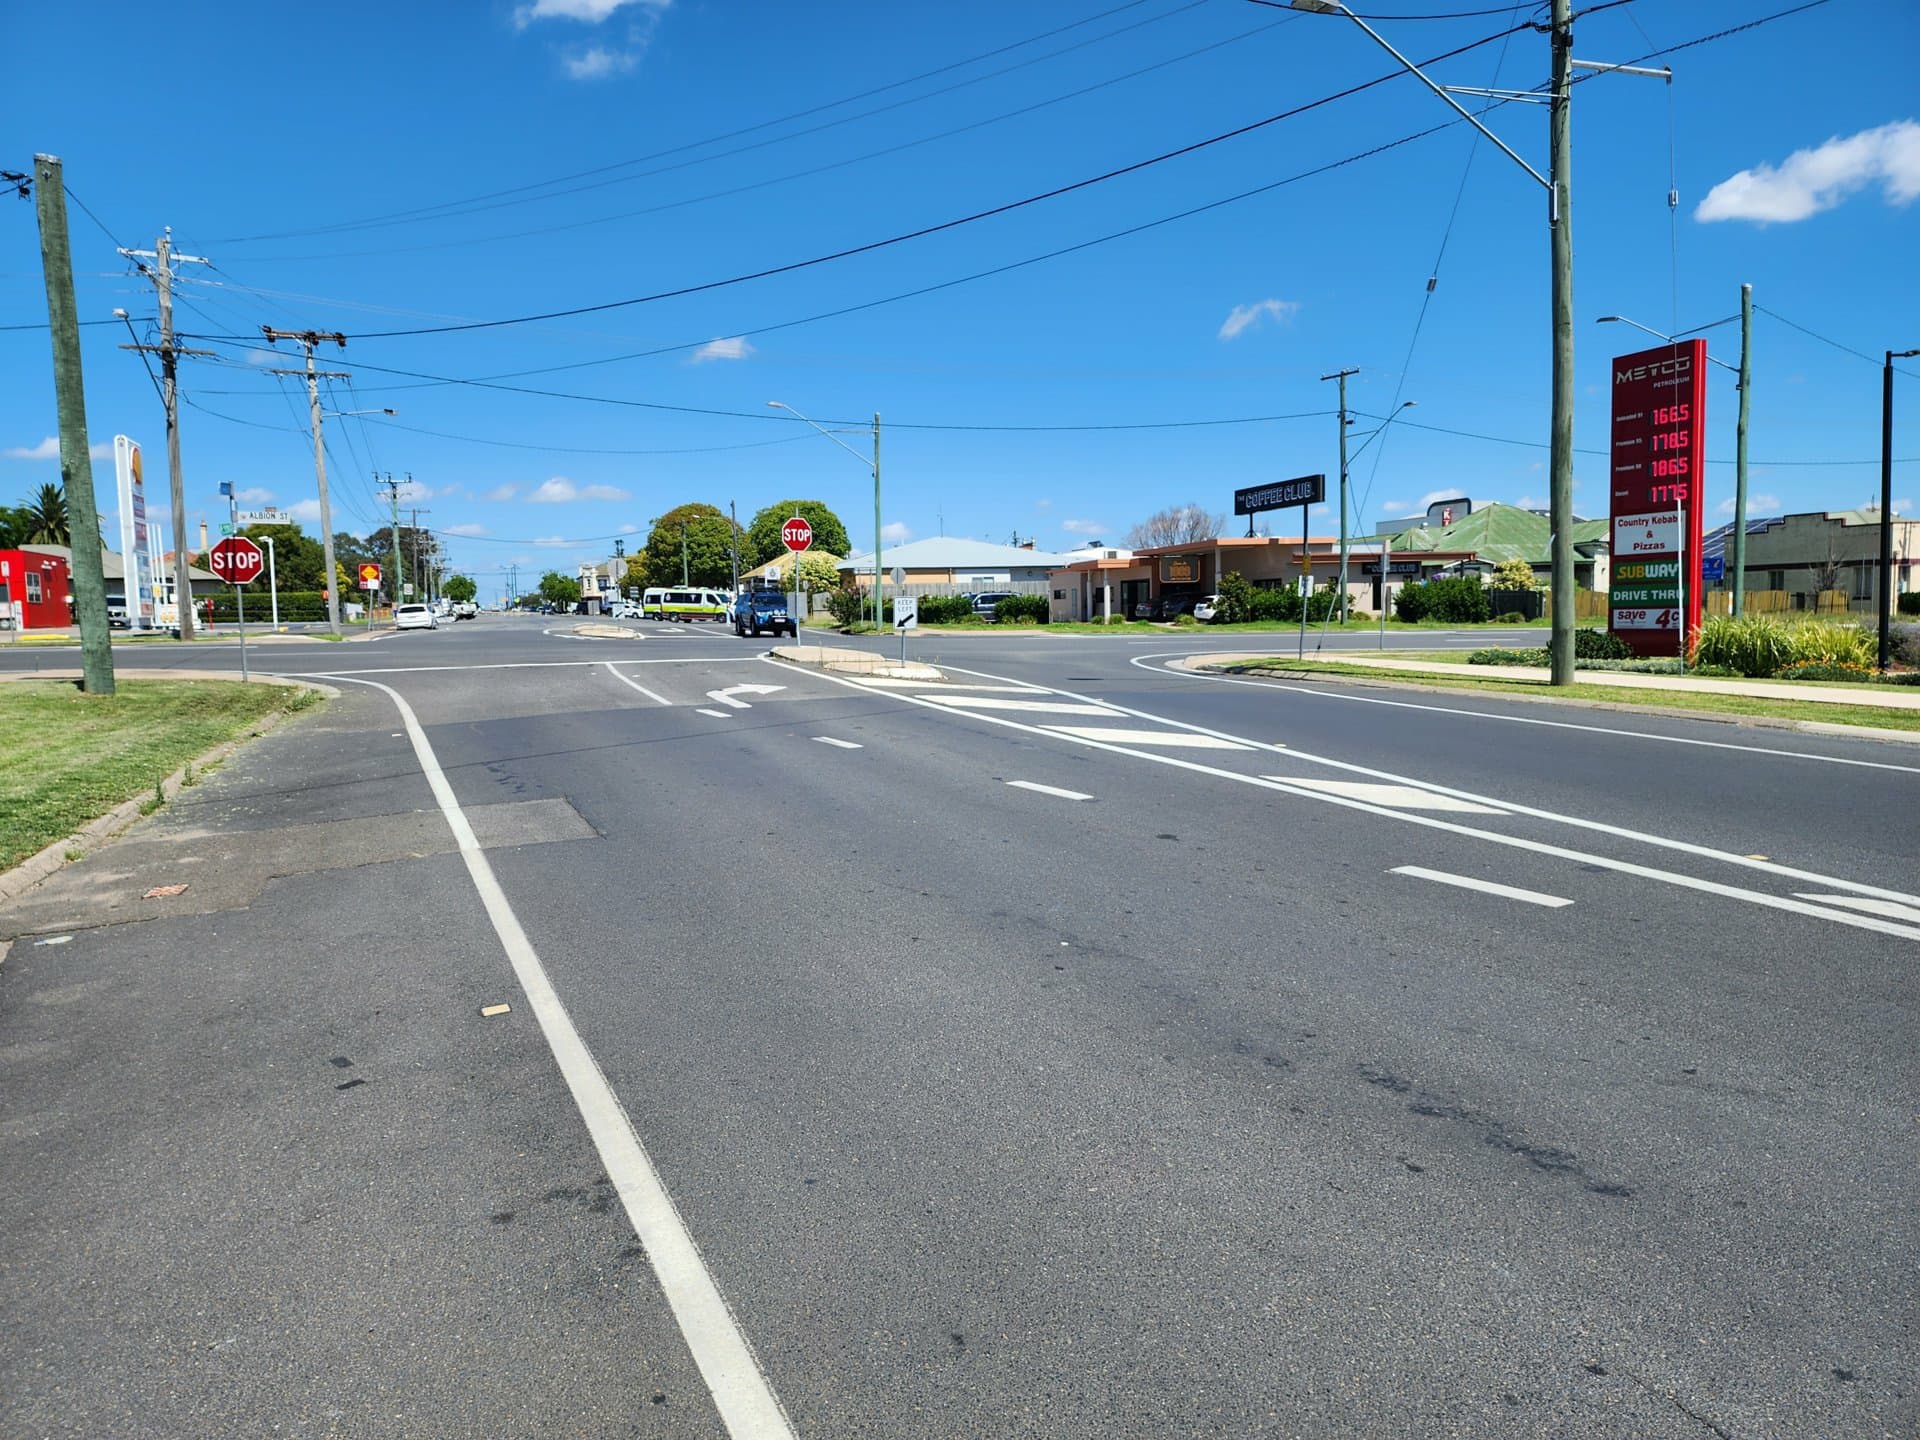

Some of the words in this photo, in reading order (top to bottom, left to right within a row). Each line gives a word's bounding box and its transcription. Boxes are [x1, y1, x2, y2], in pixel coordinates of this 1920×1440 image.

[1616, 356, 1690, 385] METCO
[1245, 487, 1283, 508] COFFEE
[1284, 481, 1313, 501] CLUB
[249, 511, 276, 520] ALBION
[280, 512, 288, 520] ST
[1618, 517, 1649, 527] Country
[1651, 515, 1683, 524] Kebab
[783, 529, 811, 542] STOP
[1633, 541, 1666, 551] Pizzas
[213, 551, 260, 569] STOP
[1616, 563, 1680, 580] SUBWAY
[1613, 590, 1648, 601] DRIVE
[1617, 610, 1646, 622] save
